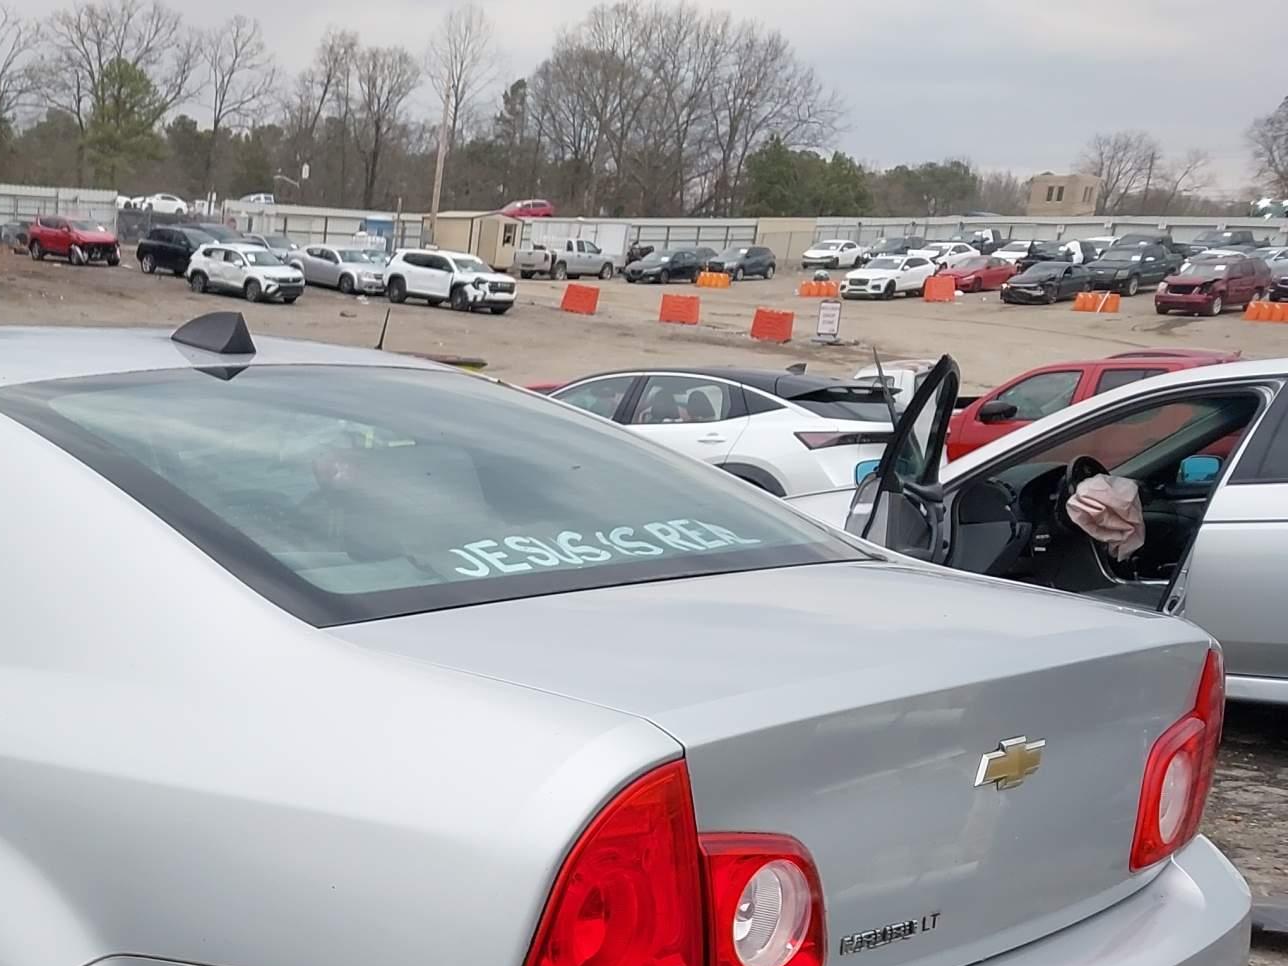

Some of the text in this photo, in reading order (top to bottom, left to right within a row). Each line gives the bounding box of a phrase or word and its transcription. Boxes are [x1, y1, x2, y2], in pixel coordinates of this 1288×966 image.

[448, 531, 612, 577] JESUS
[644, 519, 761, 552] REAL
[921, 912, 941, 932] LT
